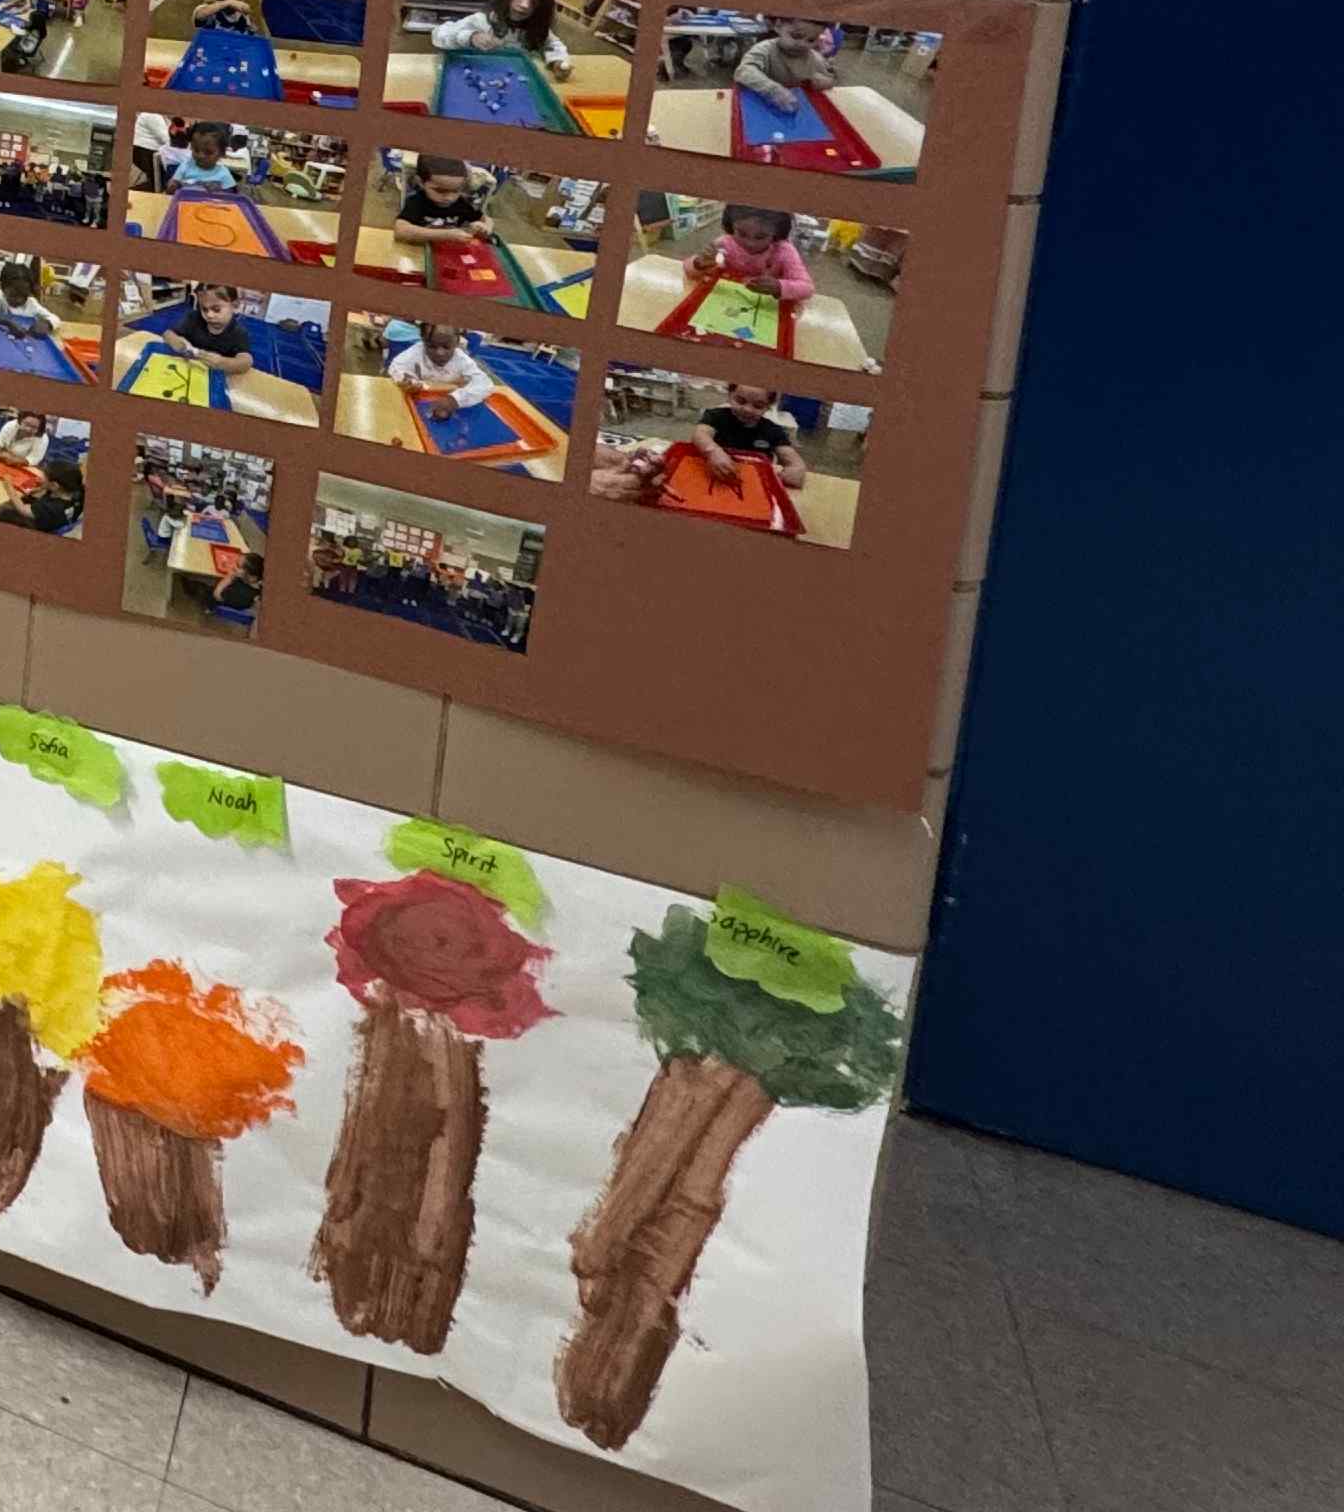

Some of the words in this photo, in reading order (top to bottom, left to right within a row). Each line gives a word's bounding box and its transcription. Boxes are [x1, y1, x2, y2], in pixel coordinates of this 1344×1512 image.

[28, 732, 70, 759] Sofia
[207, 787, 257, 815] Noah
[440, 837, 499, 873] Spirit
